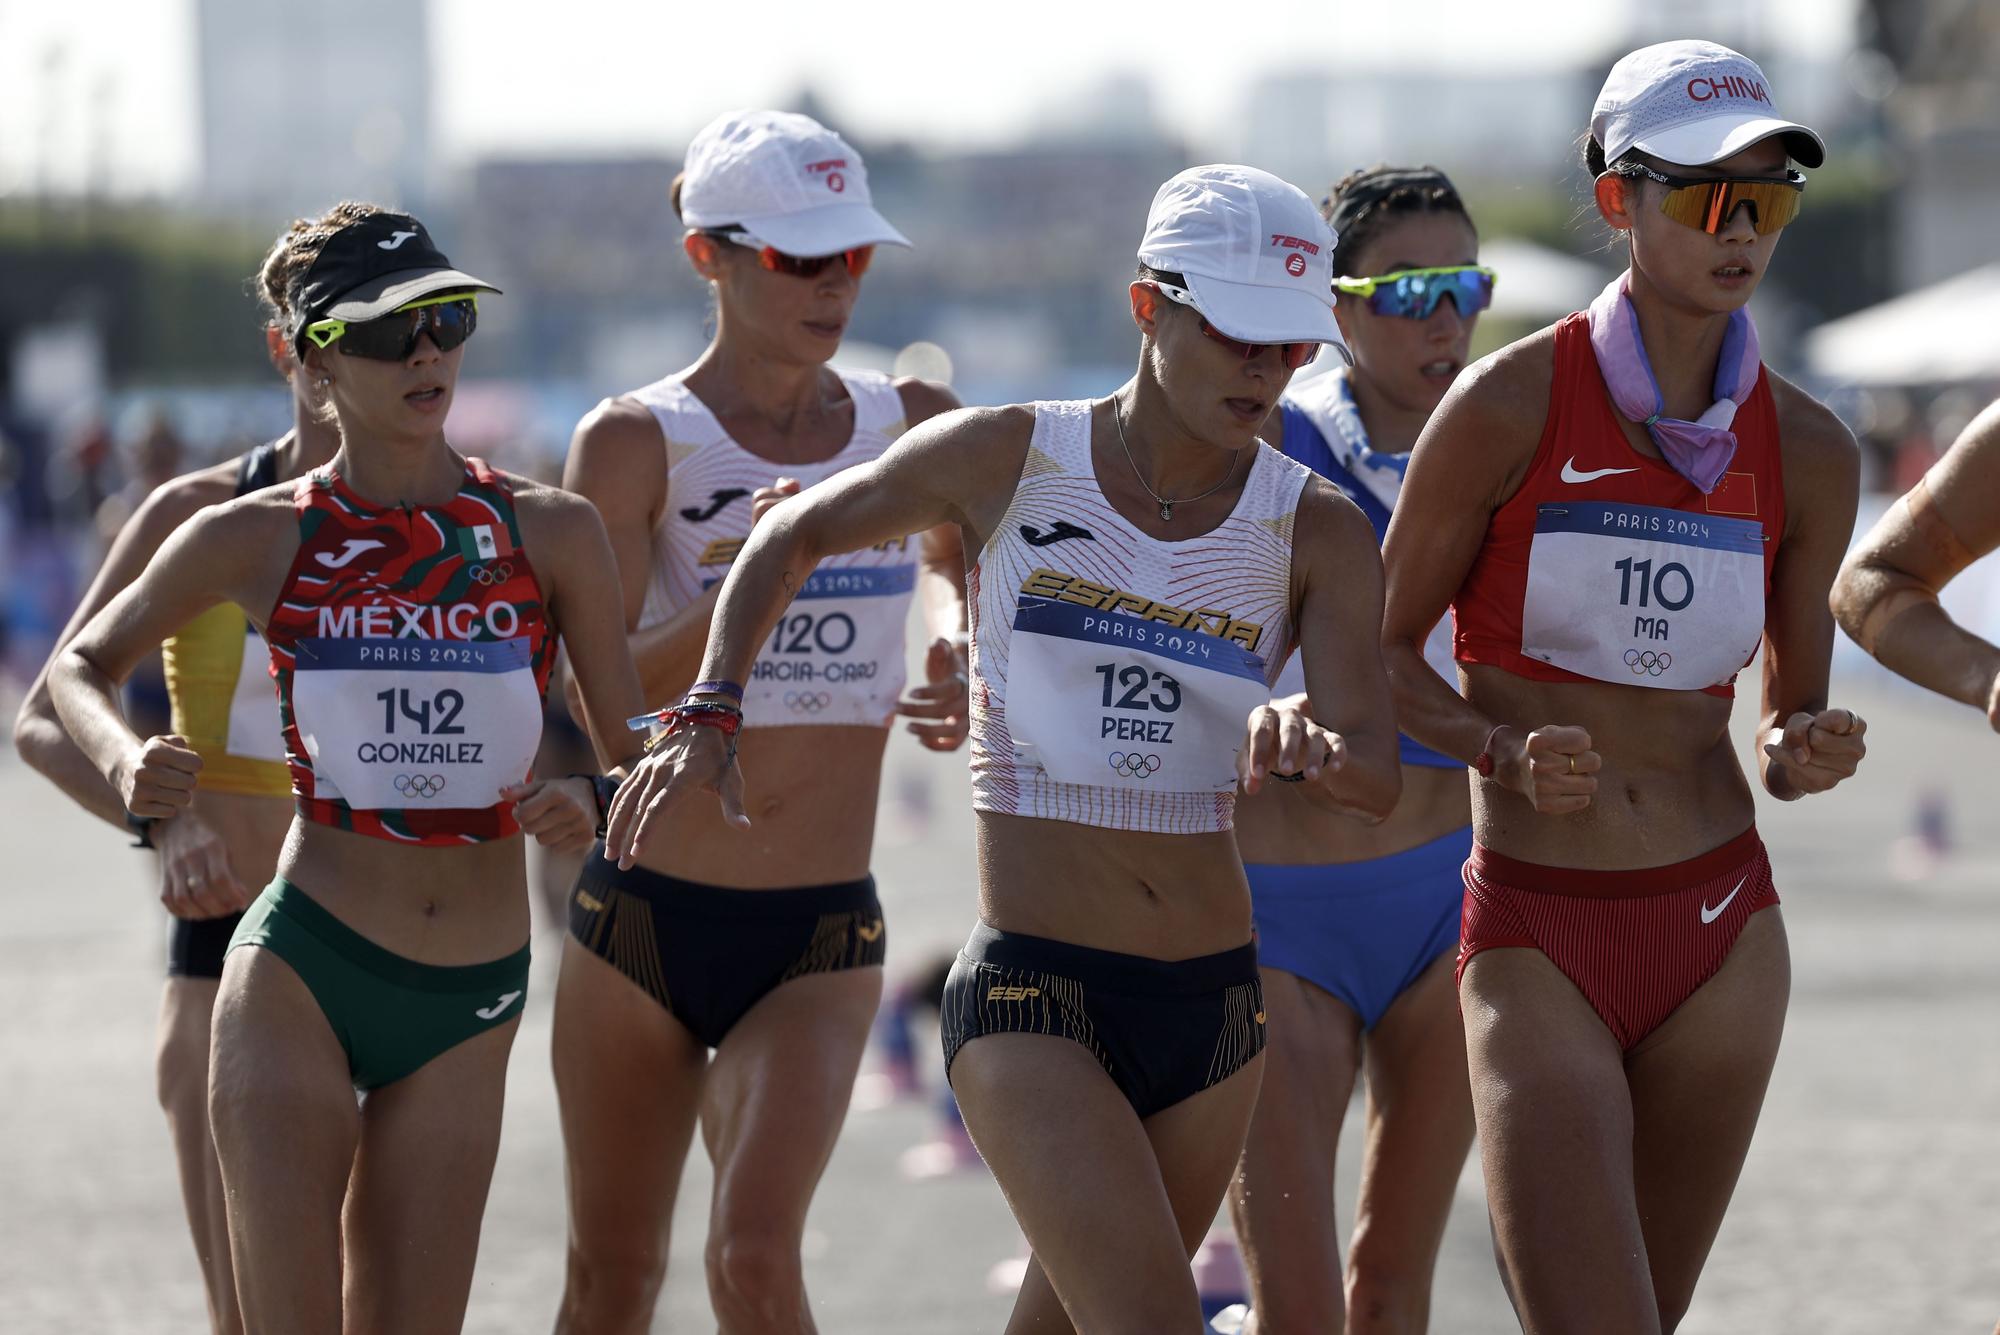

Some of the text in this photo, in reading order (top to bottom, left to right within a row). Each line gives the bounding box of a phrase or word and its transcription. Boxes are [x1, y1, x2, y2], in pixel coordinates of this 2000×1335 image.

[1687, 75, 1772, 107] CHINA
[1271, 234, 1320, 255] TEAM
[1603, 511, 1709, 538] PARIS 2024
[1614, 556, 1694, 611] 110
[318, 599, 517, 640] MÉXICO
[1019, 567, 1264, 652] ESPAÑA
[770, 612, 856, 655] 120
[1083, 616, 1211, 659] PARIS 2024
[1634, 615, 1669, 640] MA
[360, 646, 485, 665] PARIS 2024
[1095, 663, 1182, 713] 123
[377, 688, 465, 735] 142
[1101, 716, 1175, 744] PEREZ
[358, 741, 483, 765] GONZALEZ
[987, 986, 1041, 1001] ESP
